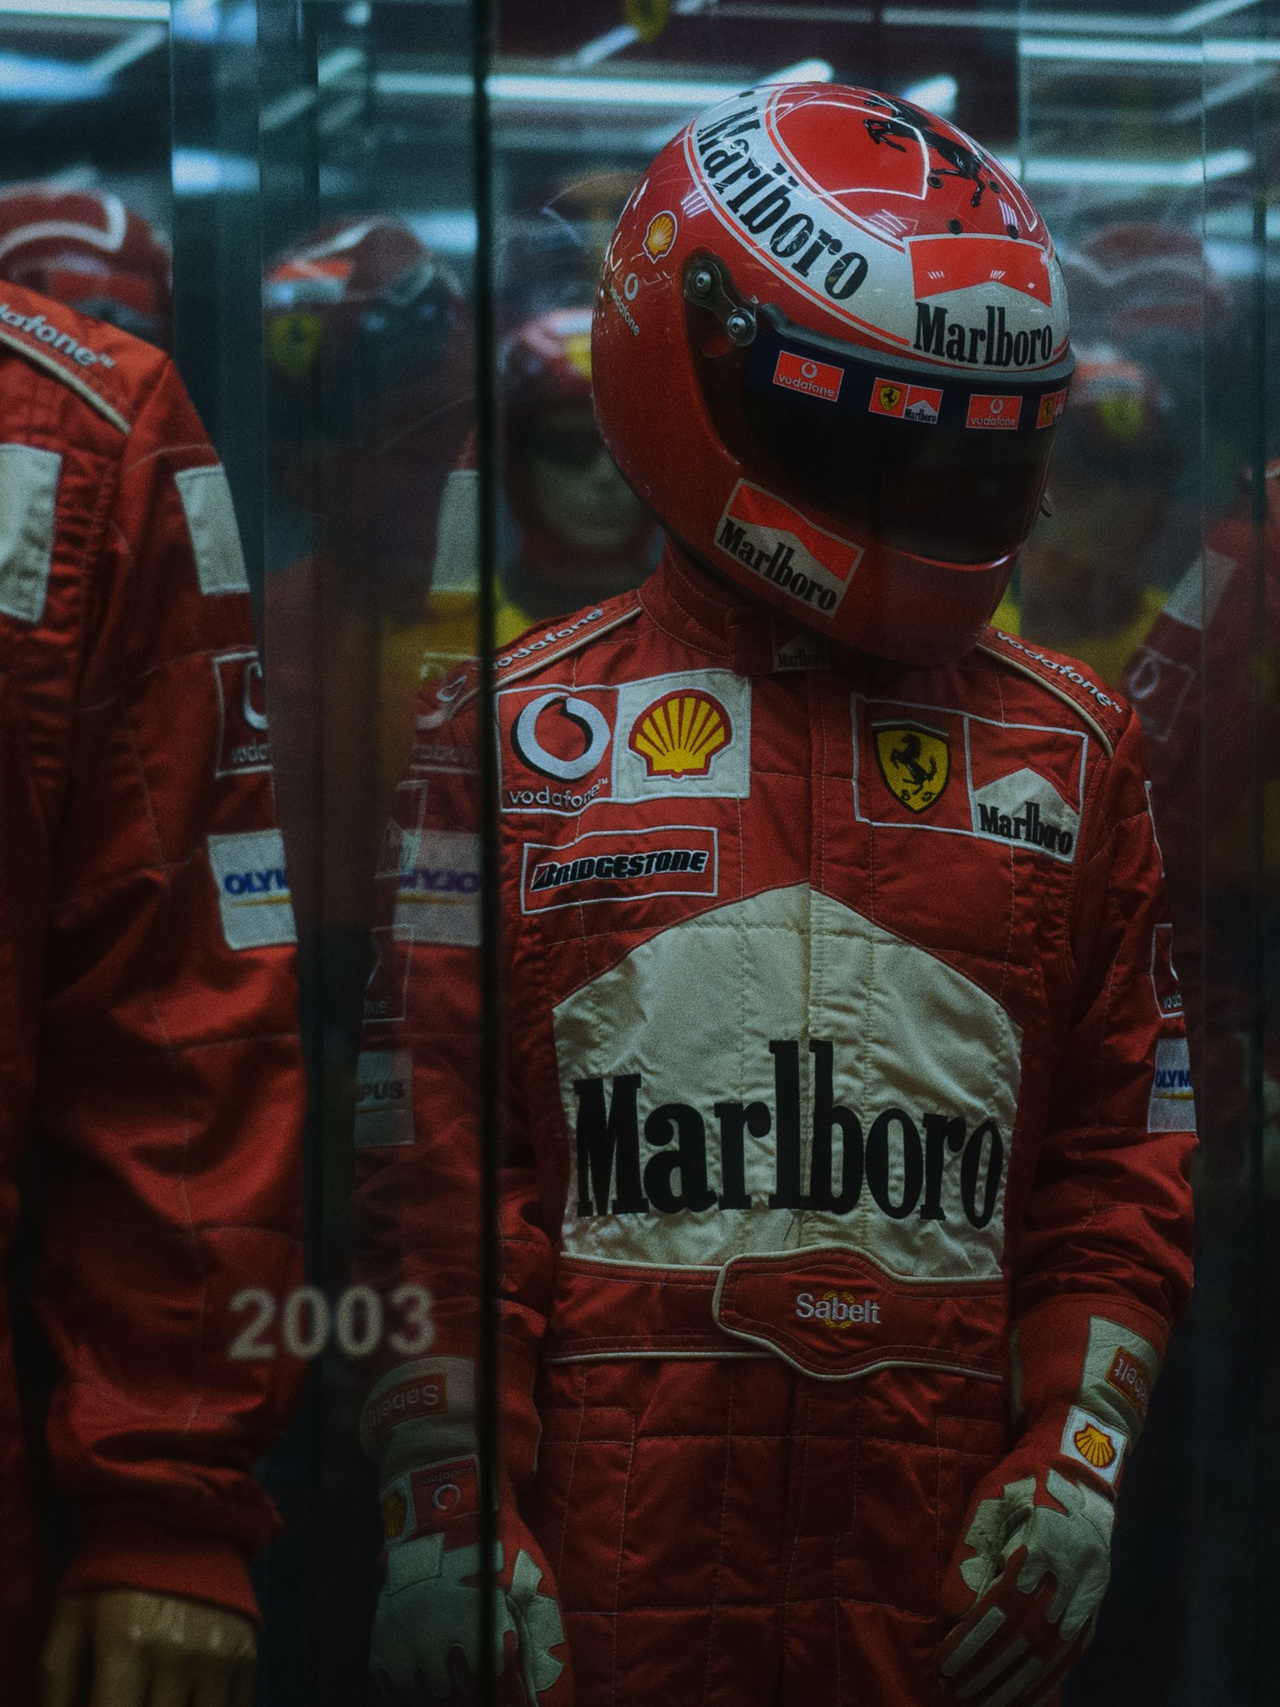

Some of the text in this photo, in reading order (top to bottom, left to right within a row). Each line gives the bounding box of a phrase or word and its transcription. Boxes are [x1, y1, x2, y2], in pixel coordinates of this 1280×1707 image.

[697, 105, 869, 300] Marlboro
[913, 301, 1053, 366] Marlboro
[779, 373, 835, 397] vodafone
[904, 408, 937, 423] Marlboro
[970, 416, 1016, 427] vodafone
[716, 517, 838, 611] Marlboro
[977, 802, 1074, 855] Marlboro
[530, 851, 709, 892] BRIDGESTONE
[574, 1040, 1003, 1229] Marlboro
[229, 1284, 437, 1361] 2003
[796, 1293, 882, 1325] Sabelt
